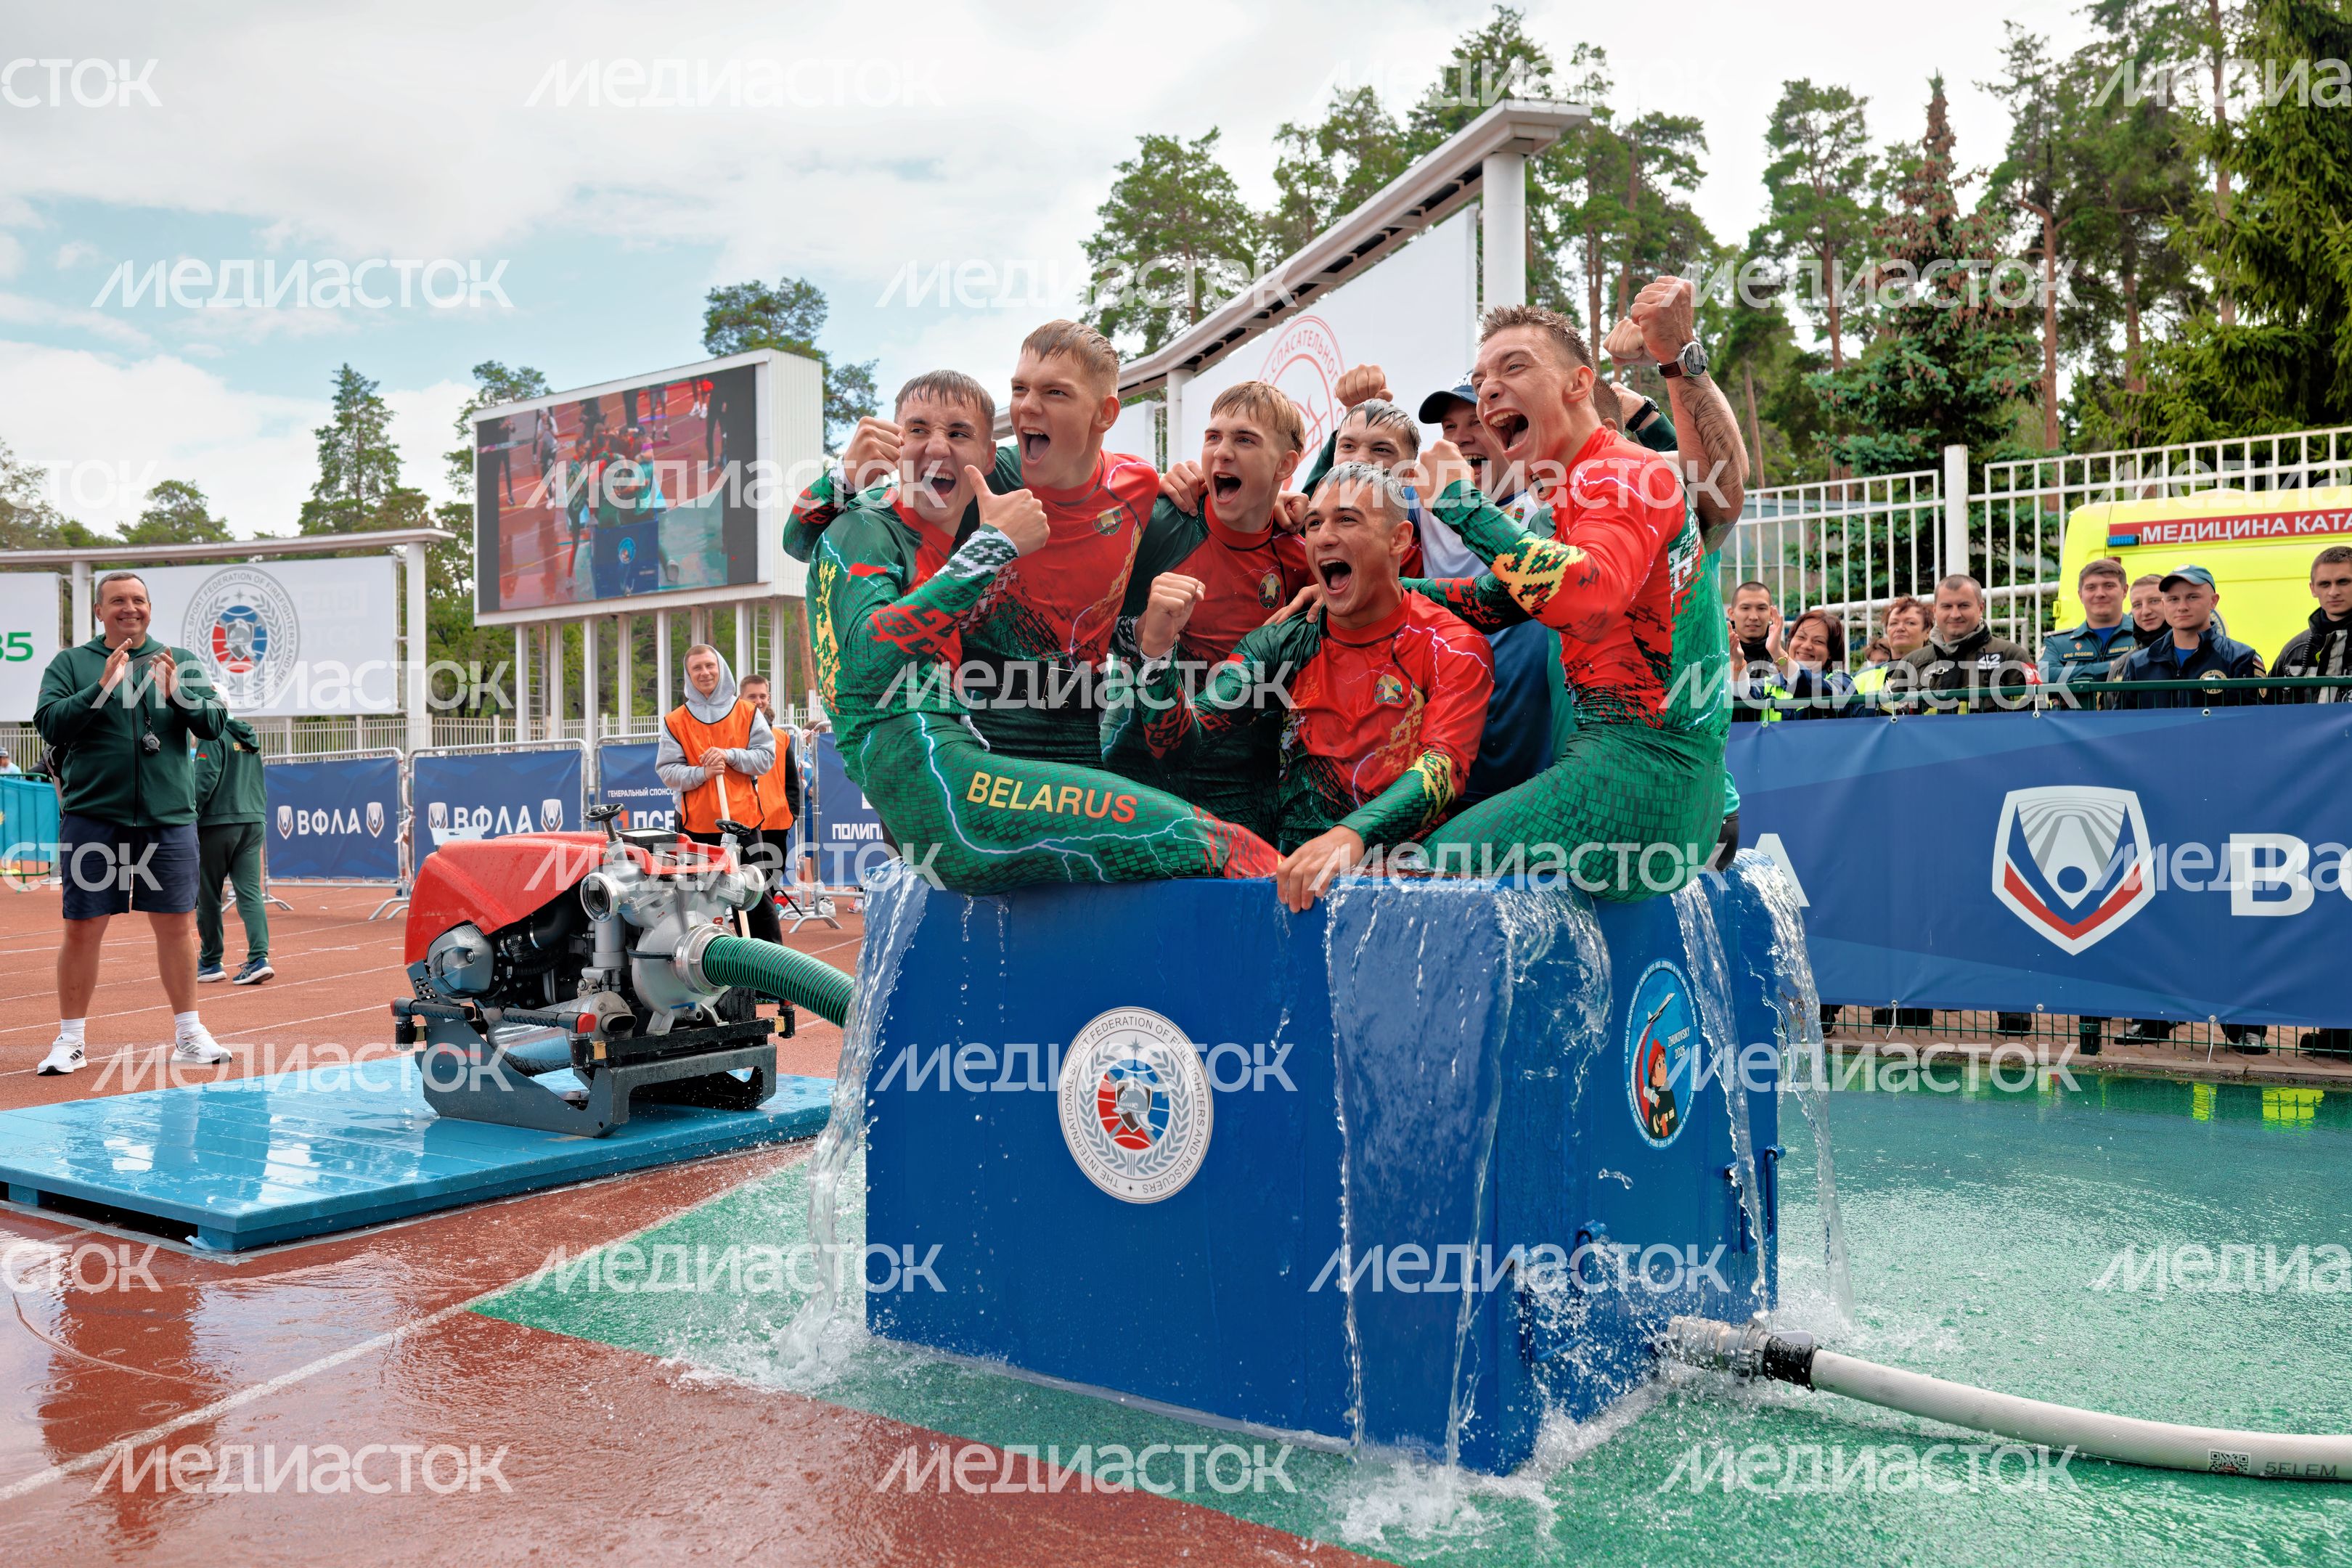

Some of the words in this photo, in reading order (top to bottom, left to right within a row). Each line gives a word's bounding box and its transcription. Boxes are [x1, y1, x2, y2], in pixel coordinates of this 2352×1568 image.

[1263, 330, 1339, 399] -СПАСАТЕЛЬНОГ
[2142, 518, 2289, 544] МЕДИЦИНА
[189, 596, 205, 626] SPORT
[203, 572, 252, 597] FEDERATION
[253, 575, 264, 587] OF
[266, 581, 295, 646] FIREFIGHTERS
[284, 648, 295, 667] AND
[0, 632, 33, 662] 5
[607, 787, 649, 799] ГЕНЕРАЛЬНЫЙ
[649, 788, 674, 797] СПОНСО
[966, 769, 1138, 823] BELARUS
[297, 807, 362, 836] ВФЛА
[832, 822, 883, 840] ПОЛИП
[2229, 833, 2352, 917] В
[1090, 1016, 1153, 1041] FEDERATION
[1155, 1024, 1170, 1038] OF
[1667, 1026, 1691, 1048] ZHUKOVSKY
[1069, 1037, 1090, 1076] SPORT
[1169, 1035, 1206, 1127] FIREFIGHTERS
[1064, 1079, 1099, 1172] INTERNATIONAL
[1191, 1132, 1204, 1156] AND
[1099, 1171, 1119, 1188] THE
[1142, 1157, 1193, 1194] RESCUERS
[2263, 1461, 2337, 1477] 5ELEM
